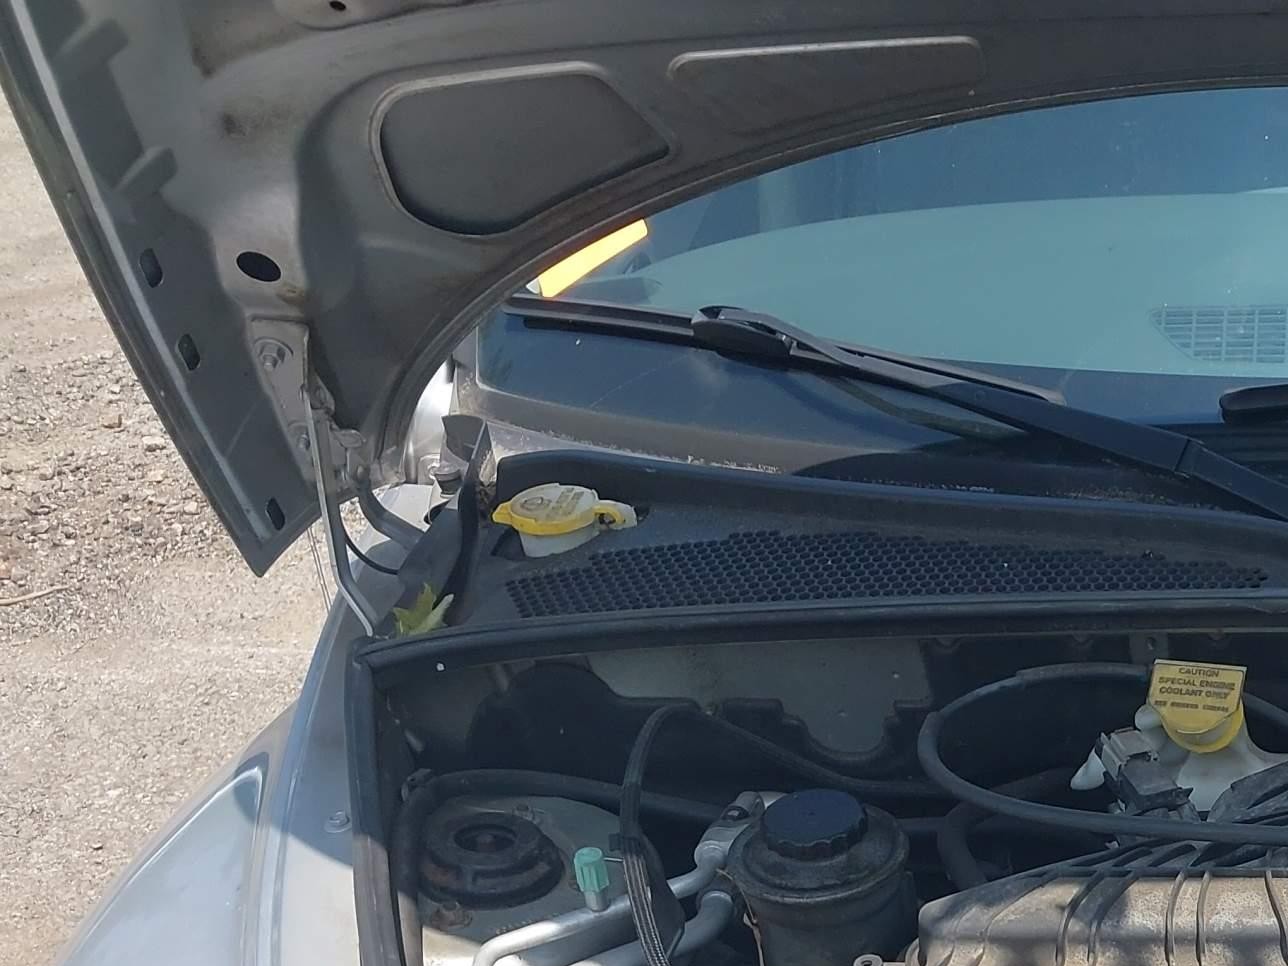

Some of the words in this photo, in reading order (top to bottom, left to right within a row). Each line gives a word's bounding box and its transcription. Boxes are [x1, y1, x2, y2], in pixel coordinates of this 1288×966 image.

[1178, 667, 1220, 677] CAUTION
[1158, 677, 1197, 687] SPECIAL
[1159, 686, 1203, 697] COOLANT
